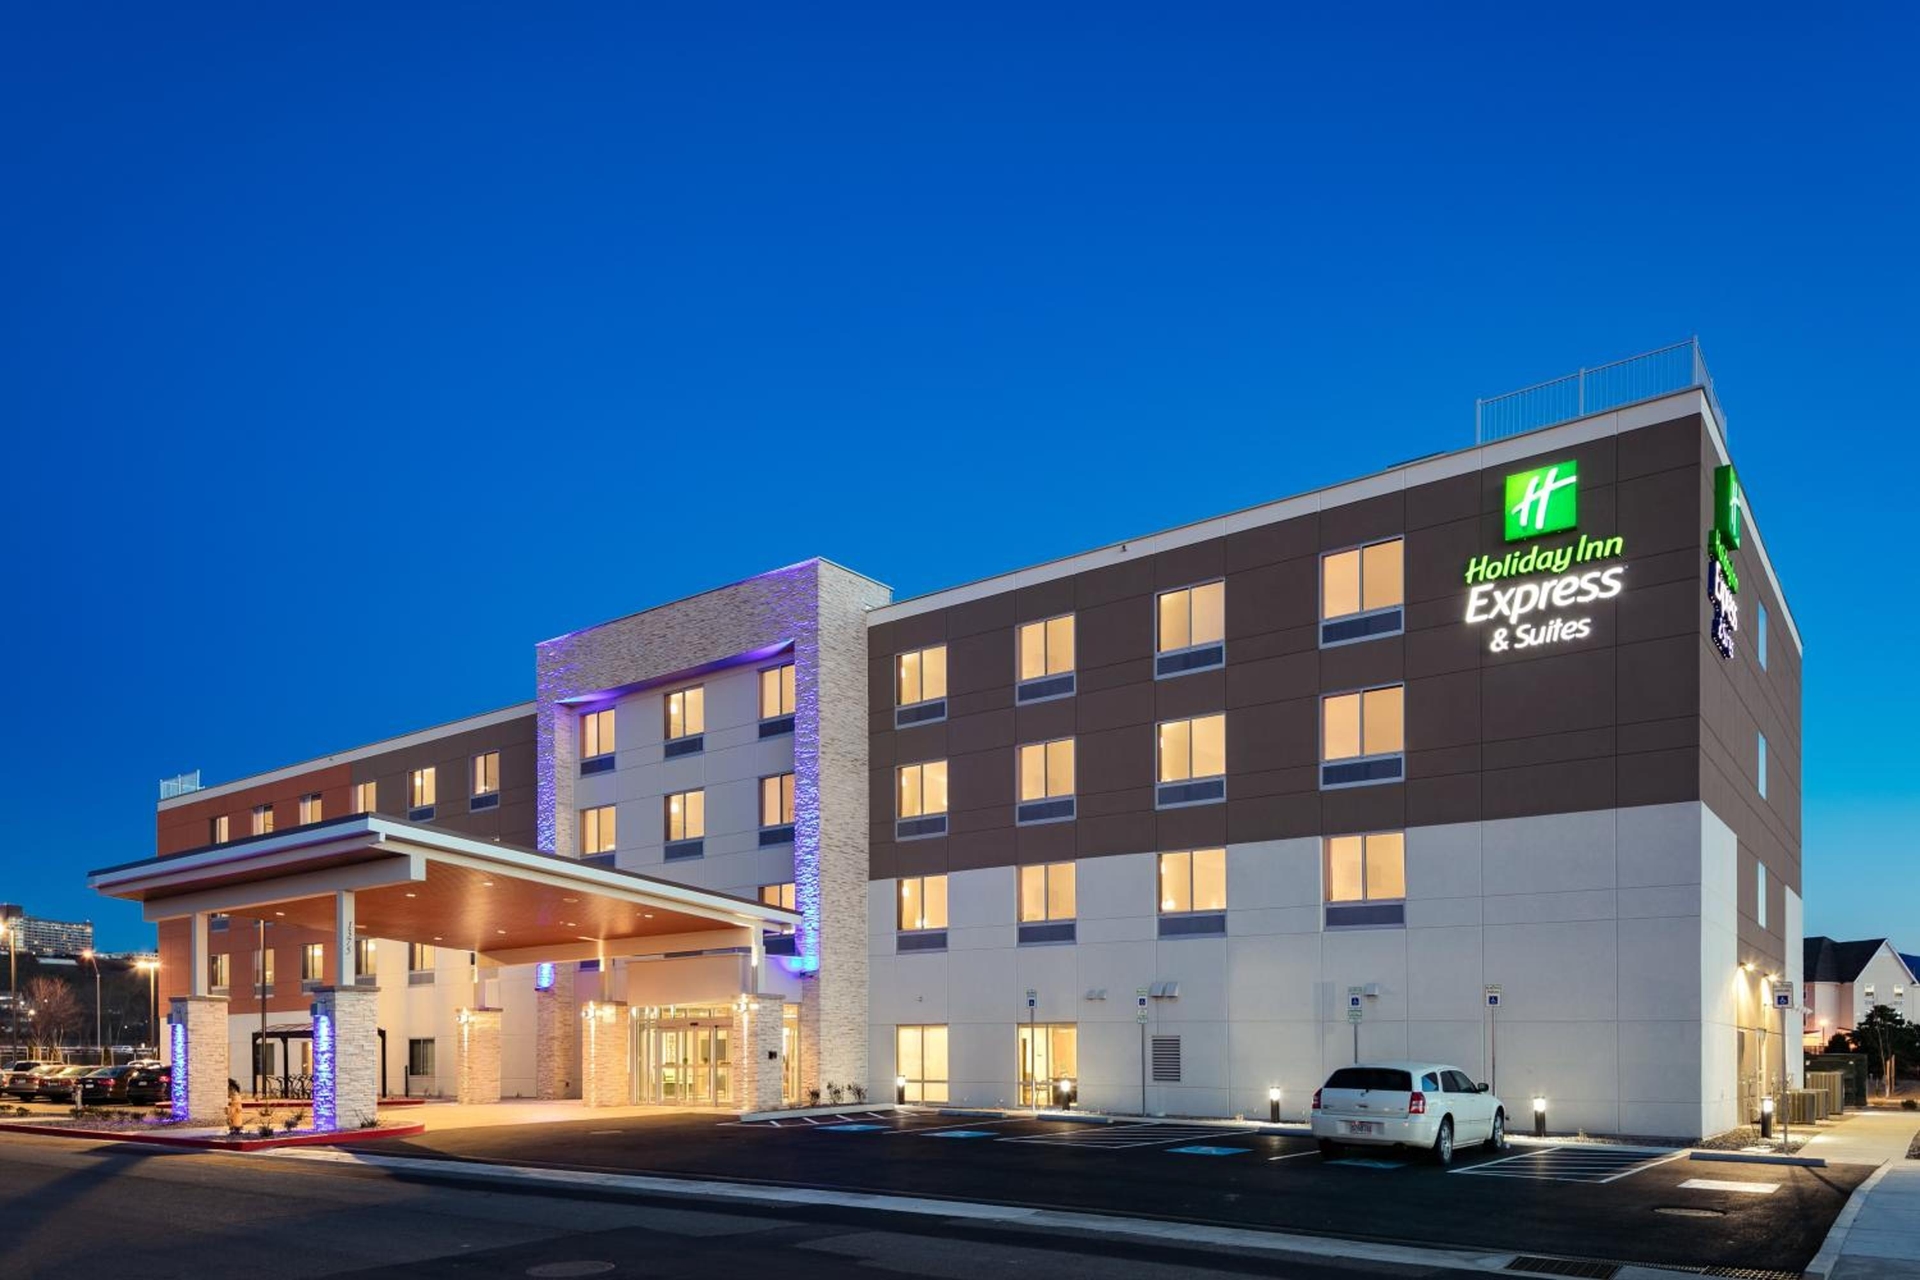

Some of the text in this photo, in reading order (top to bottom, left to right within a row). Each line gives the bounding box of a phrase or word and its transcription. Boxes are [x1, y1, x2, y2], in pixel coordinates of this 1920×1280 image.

[1511, 467, 1577, 530] H
[1465, 534, 1623, 584] Holiday Inn
[1465, 566, 1624, 624] Express
[1489, 618, 1591, 652] & Suites
